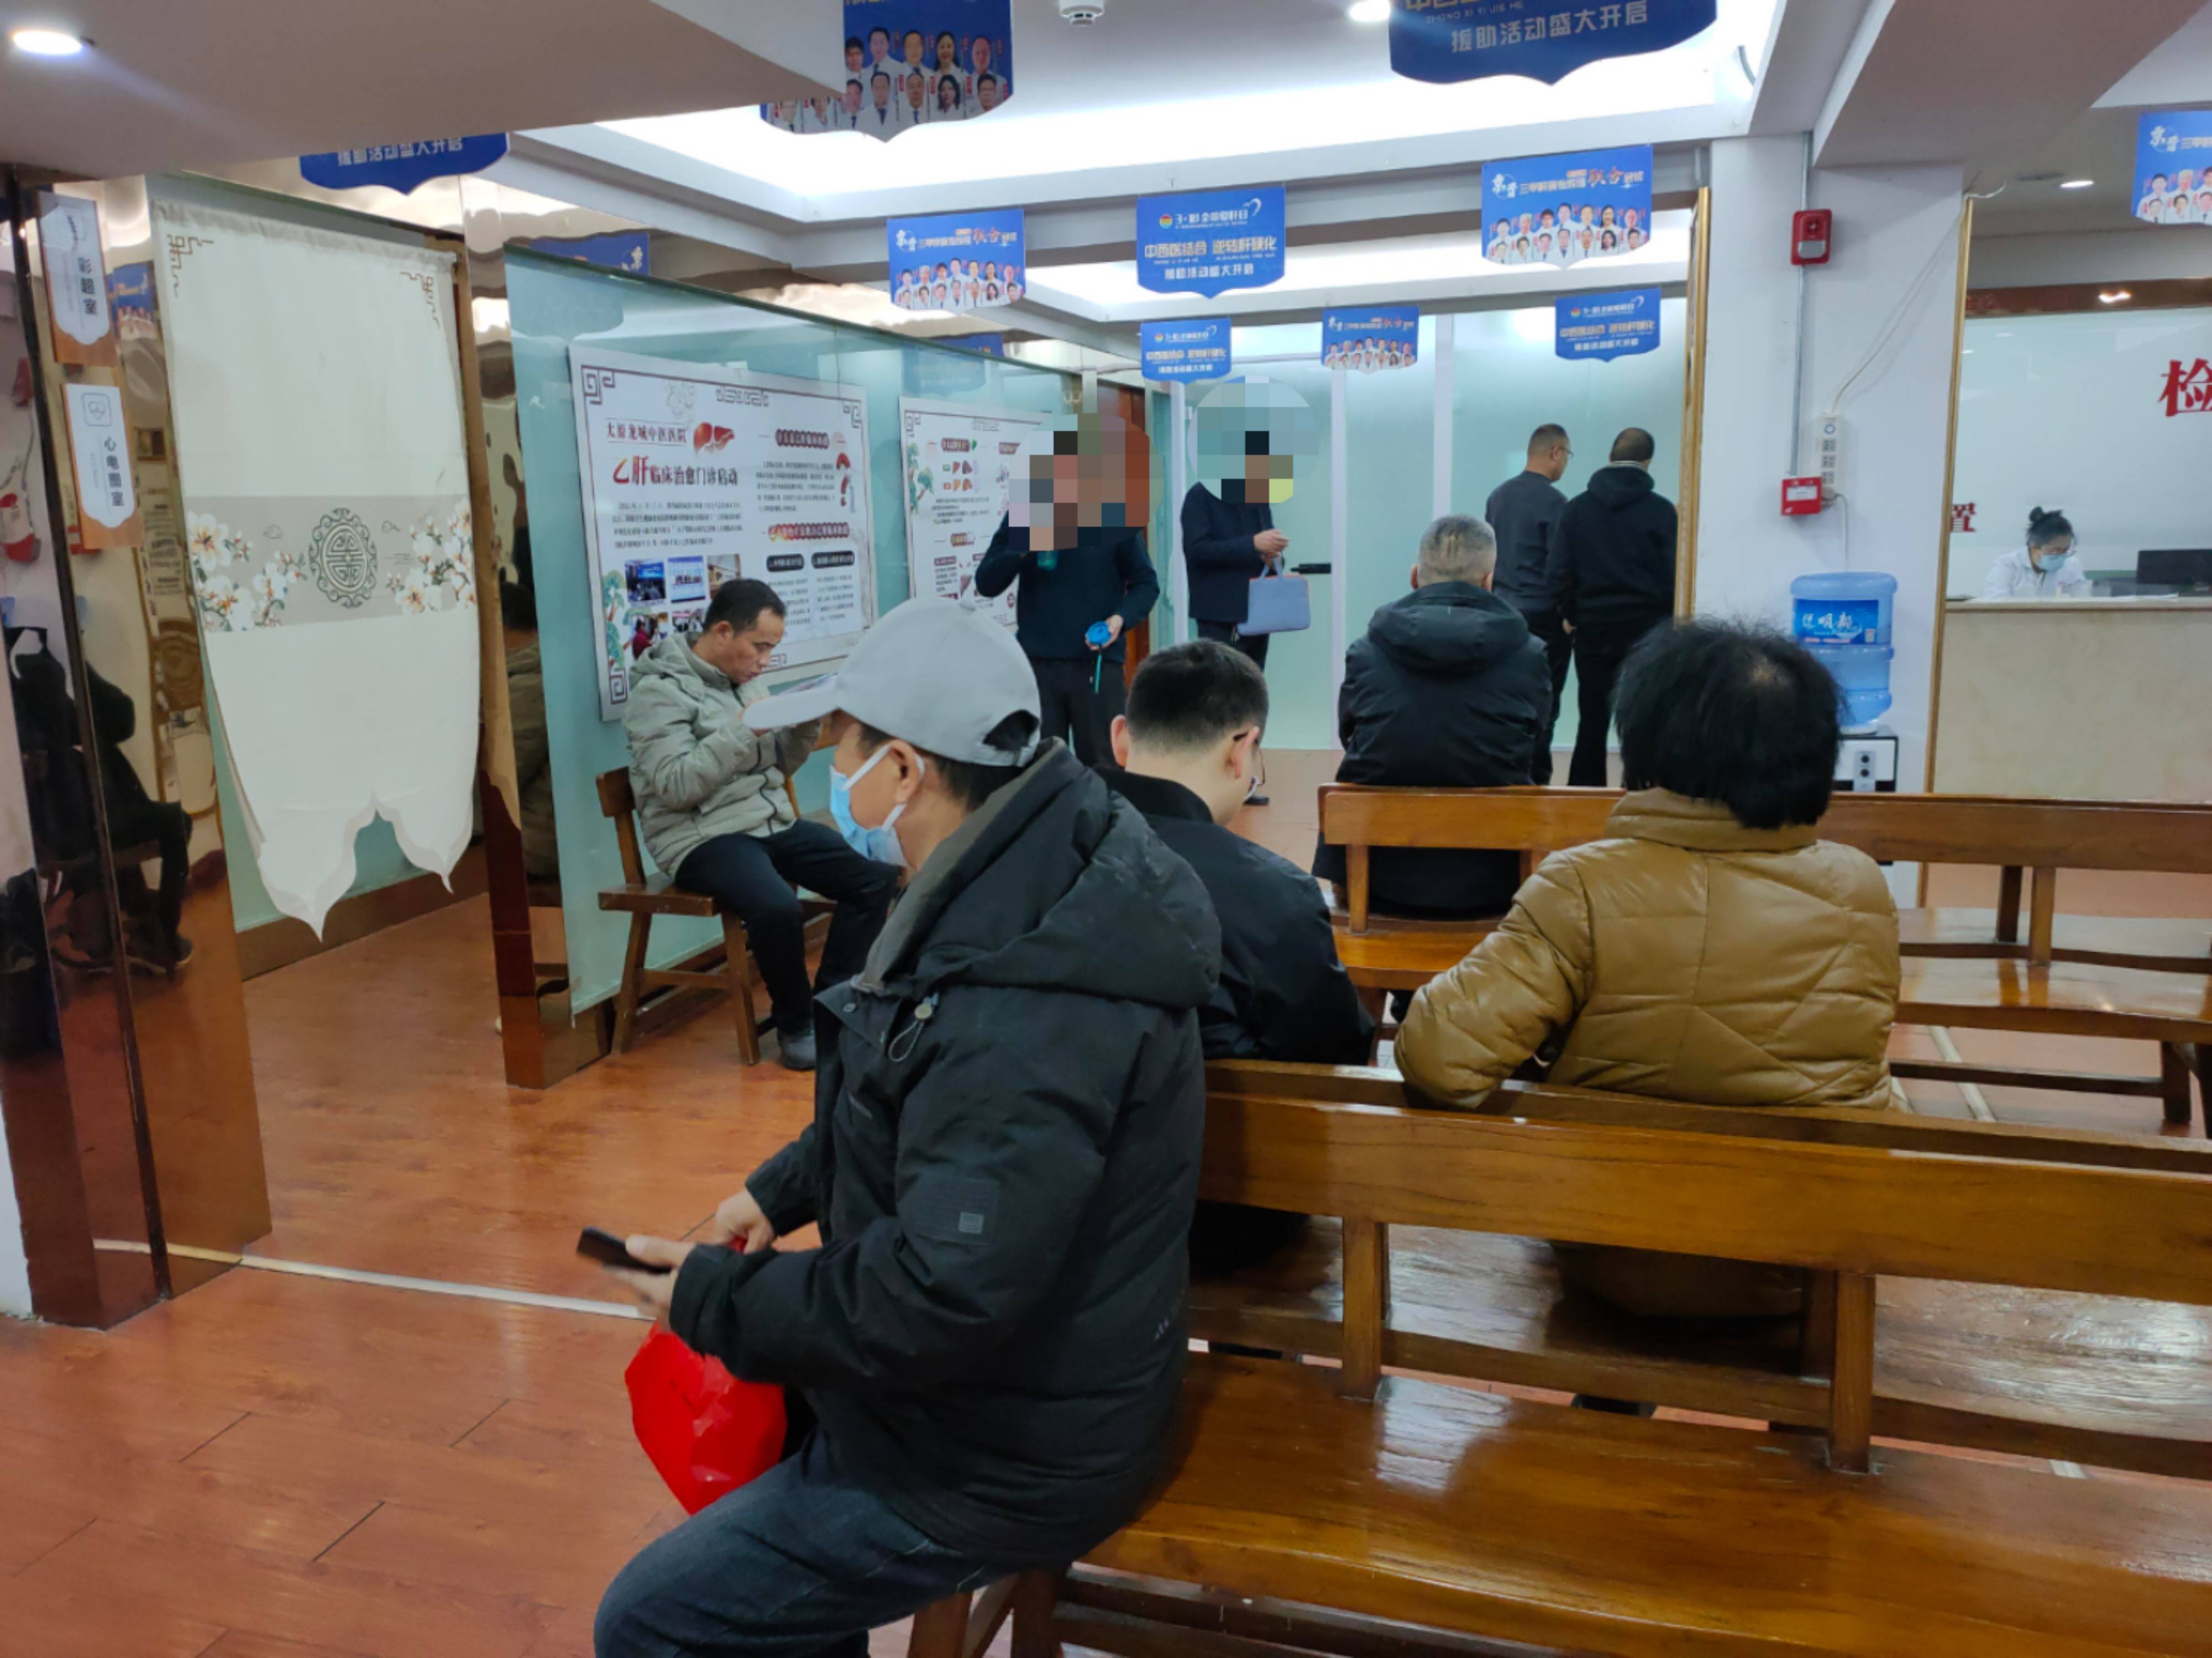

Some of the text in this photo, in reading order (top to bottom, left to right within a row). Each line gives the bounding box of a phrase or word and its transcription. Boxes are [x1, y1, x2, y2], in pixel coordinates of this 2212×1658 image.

[1451, 2, 1648, 53] 援助活动盛大开启
[1144, 240, 1207, 258] 中西医结合
[104, 436, 124, 506] 心电图室
